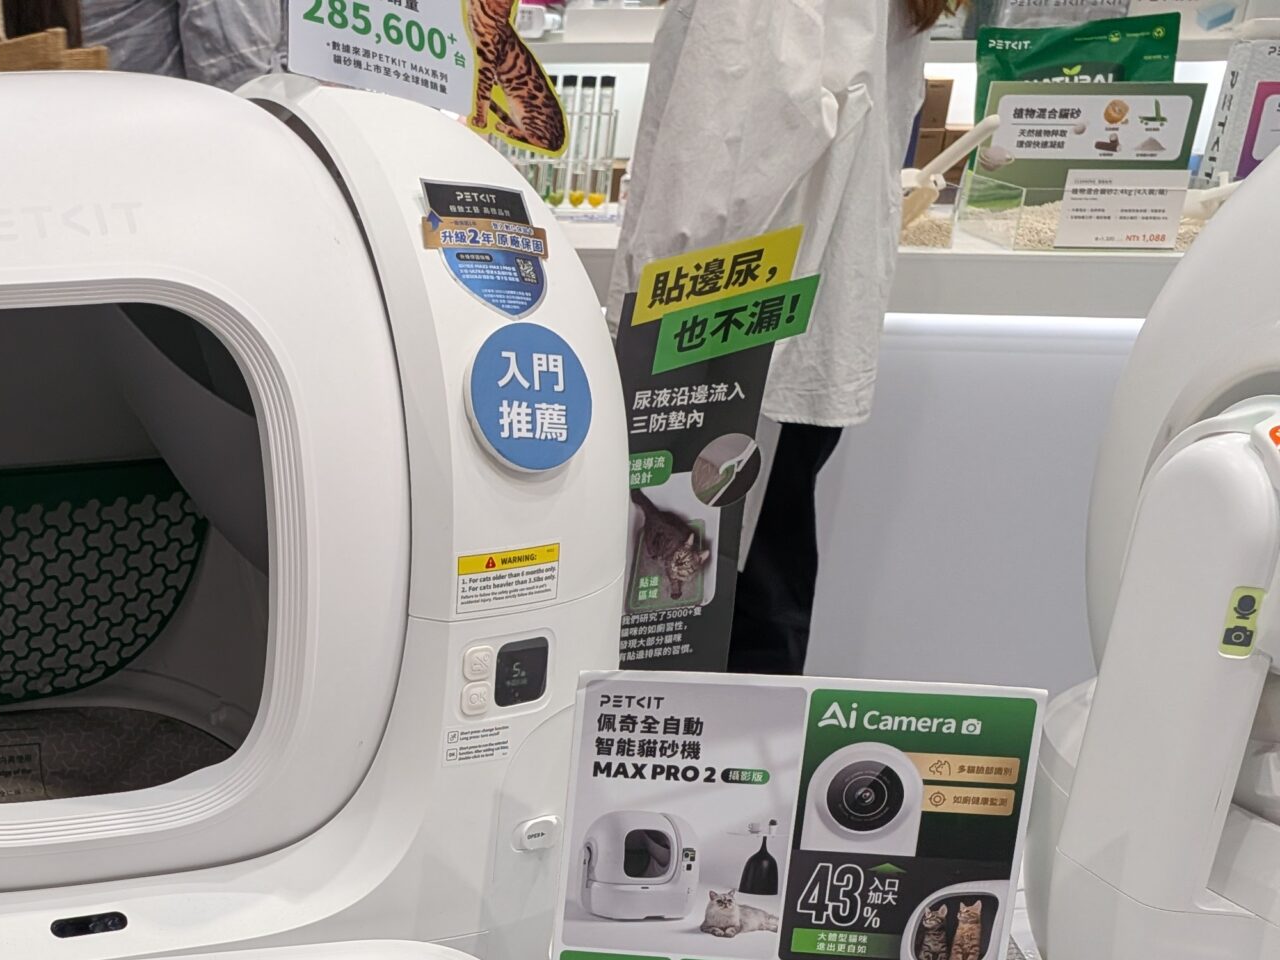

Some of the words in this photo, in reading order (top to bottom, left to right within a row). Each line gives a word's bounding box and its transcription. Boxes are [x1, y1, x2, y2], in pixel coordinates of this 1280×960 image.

[988, 39, 1032, 50] PETKIT
[454, 52, 466, 68] 台
[1012, 107, 1082, 120] 植物混合貓砂
[455, 191, 497, 204] PETKIT
[441, 228, 494, 245] 升級2年
[496, 232, 545, 254] 原廠保固
[497, 350, 565, 393] 入門
[632, 380, 746, 410] 尿液沿邊流入
[499, 401, 568, 442] 推薦
[629, 409, 705, 434] 三防墊內
[629, 472, 653, 486] 設計
[500, 553, 537, 566] WARNING:
[492, 573, 507, 581] older
[507, 571, 520, 579] than
[525, 568, 544, 577] months
[492, 581, 514, 590] heavier
[600, 694, 665, 709] PETKIT
[596, 712, 704, 736] 佩奇全自動
[817, 701, 858, 729] Ai
[862, 710, 957, 734] Camera
[595, 736, 701, 760] 智能貓砂機
[592, 761, 648, 780] MAX
[651, 765, 700, 782] PRO
[703, 767, 717, 783] 2
[727, 770, 764, 783] 攝影版
[868, 876, 900, 892] 入口
[796, 862, 865, 927] 43
[866, 891, 899, 905] 加大
[862, 906, 881, 929] %
[817, 932, 869, 944] 大體型貓咪
[816, 942, 867, 954] 進出更自如
